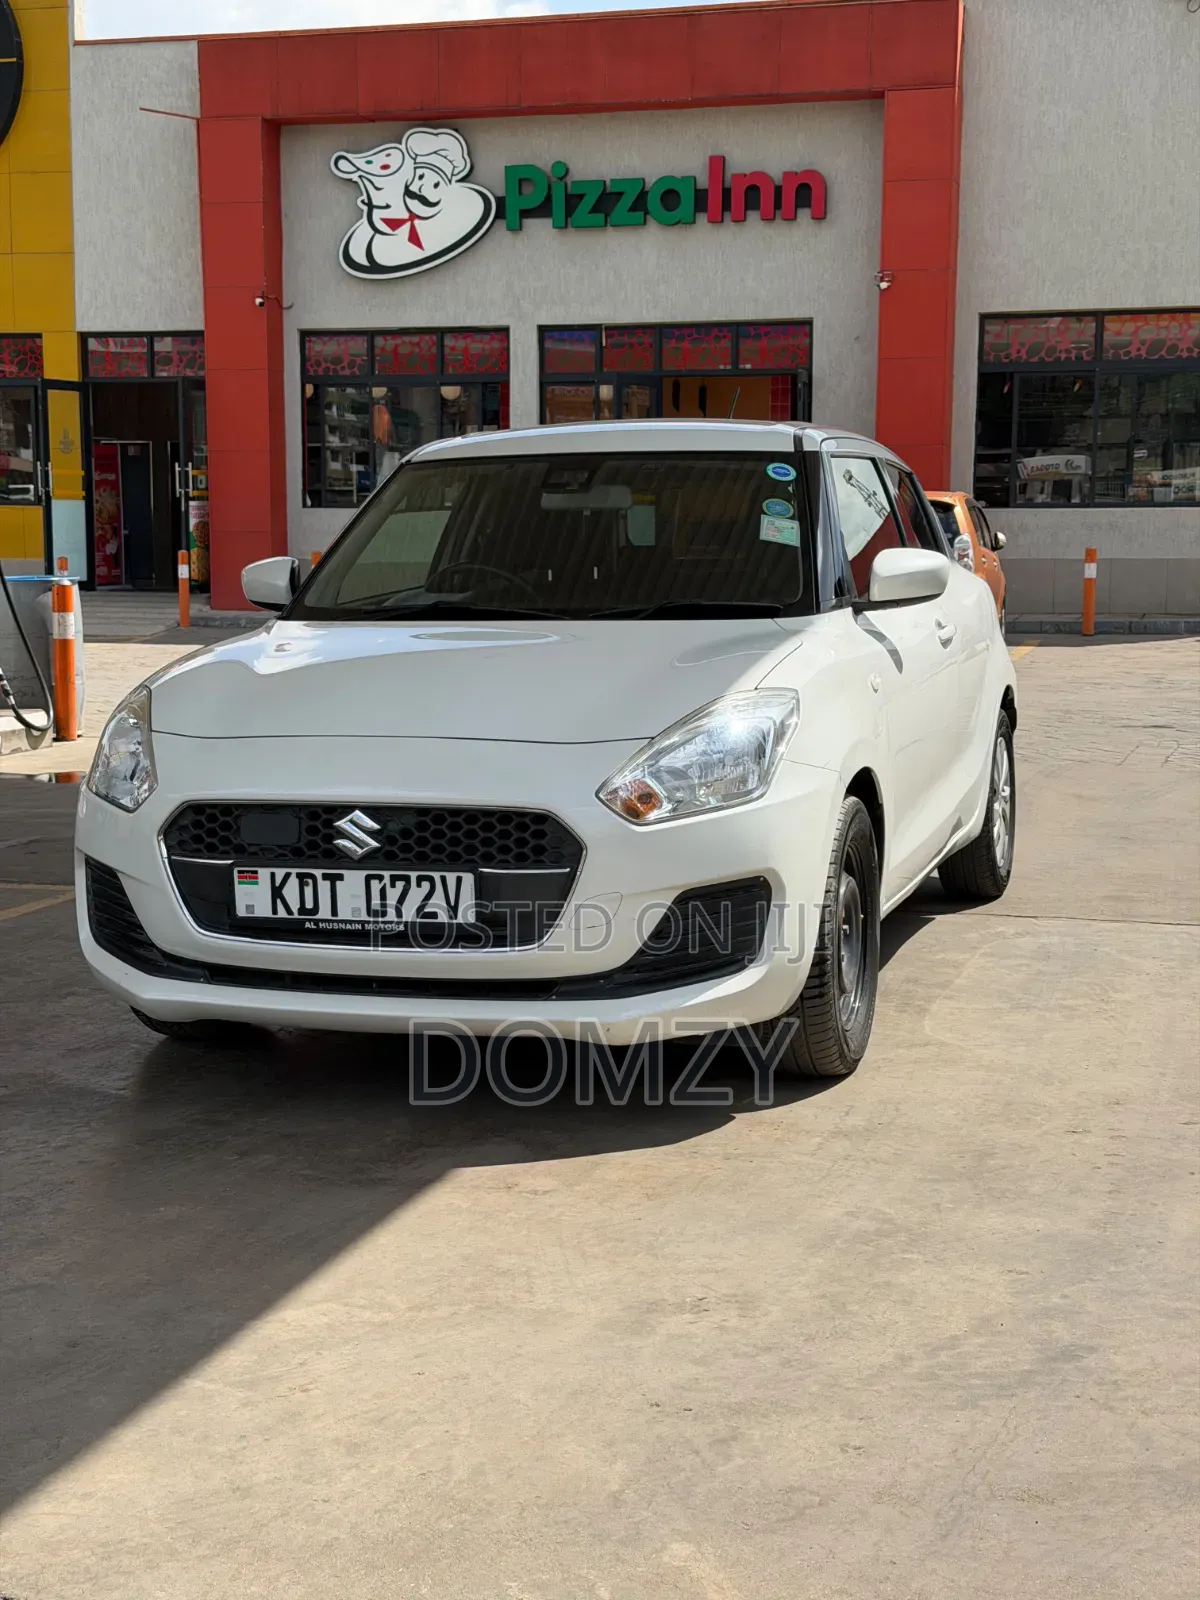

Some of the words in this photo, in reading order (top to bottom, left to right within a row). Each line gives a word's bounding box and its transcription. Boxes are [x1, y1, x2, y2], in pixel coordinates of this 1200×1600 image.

[505, 160, 696, 231] Pizza
[707, 155, 827, 223] Inn
[270, 871, 344, 918] KDT
[304, 921, 317, 929] AL
[319, 922, 362, 931] HUSNAIN
[364, 923, 405, 932] MOTORS
